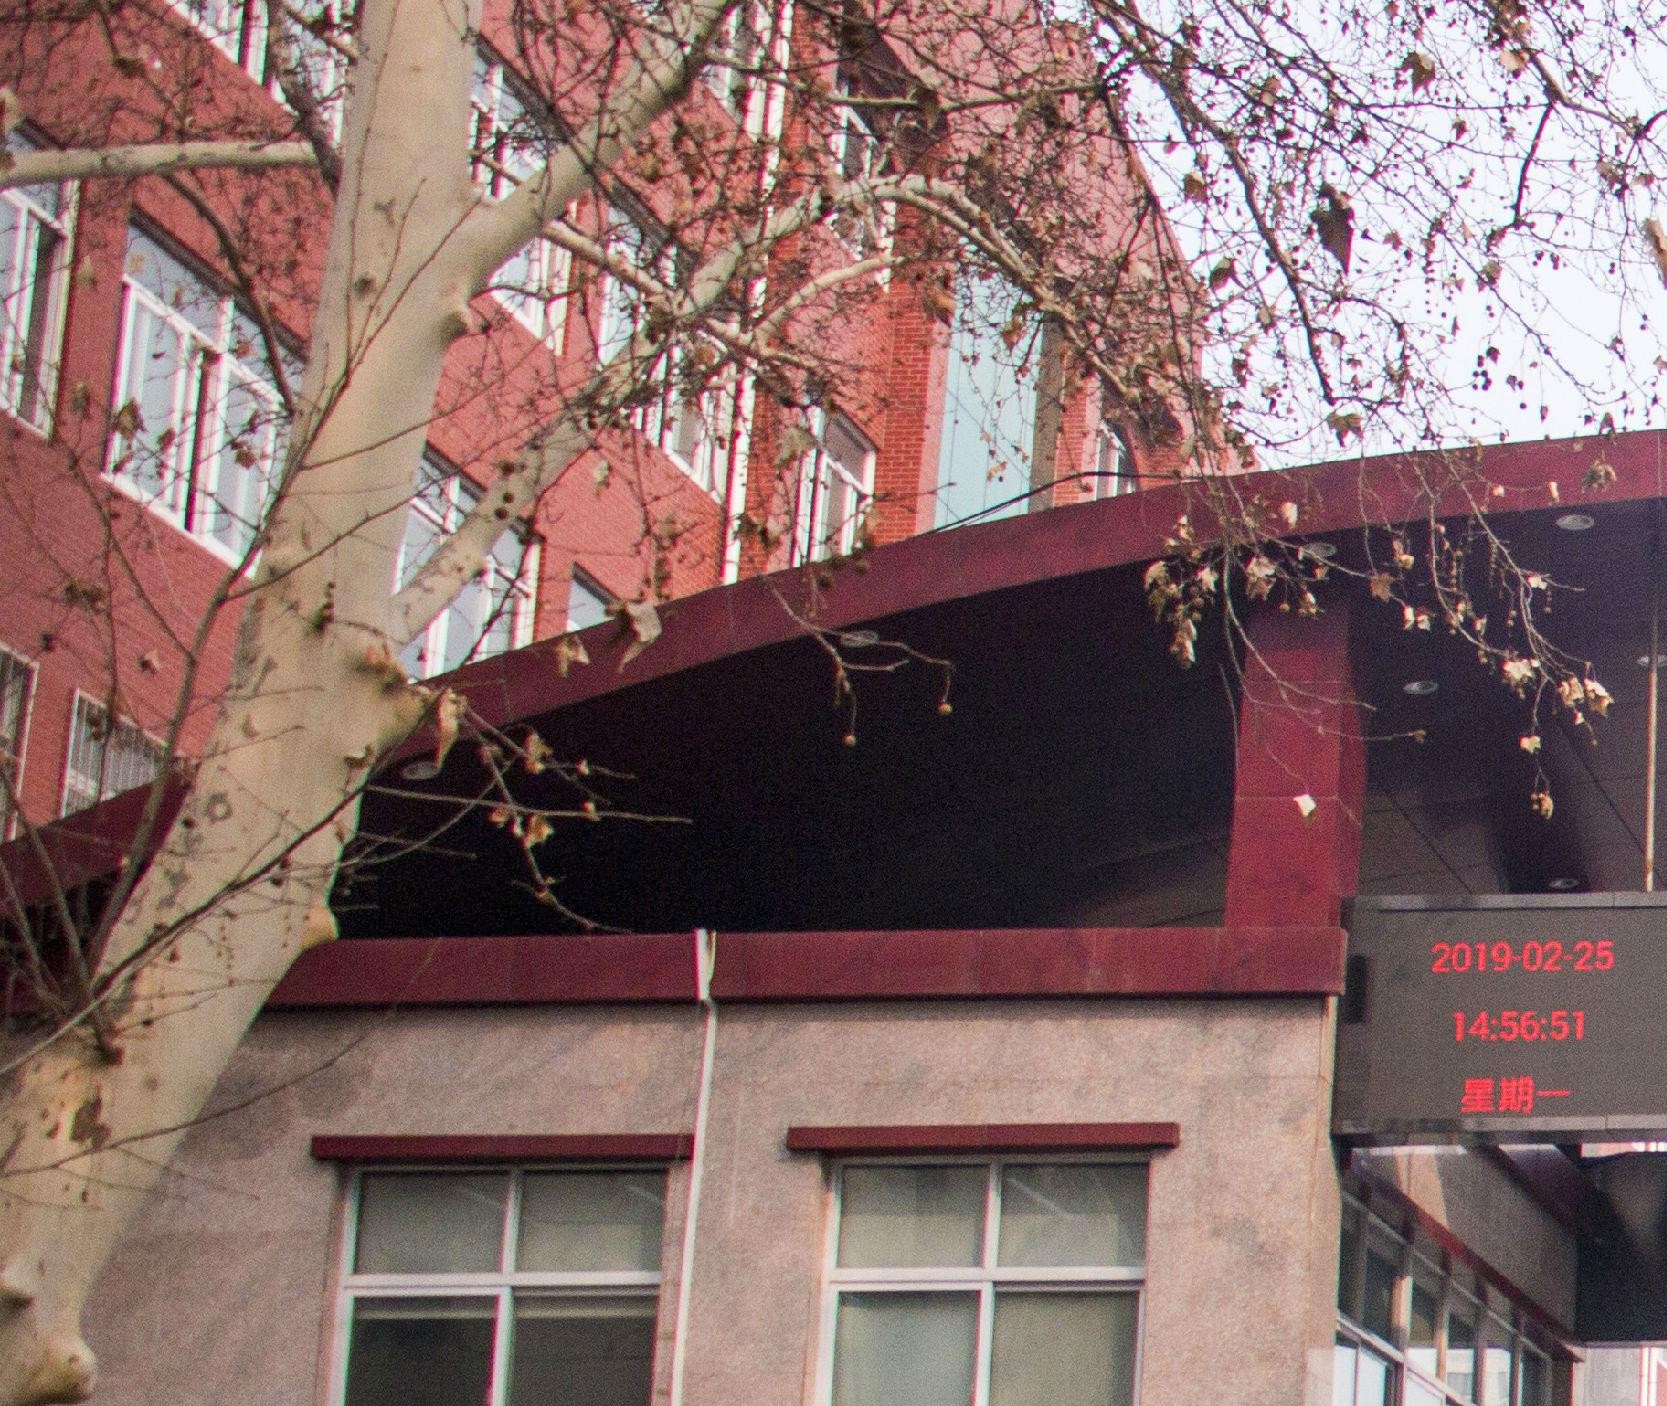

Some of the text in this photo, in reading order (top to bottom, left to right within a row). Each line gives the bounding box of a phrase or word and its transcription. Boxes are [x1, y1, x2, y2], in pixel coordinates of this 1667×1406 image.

[1432, 940, 1617, 975] 2019-02-25
[1454, 1010, 1586, 1043] 14:56:51
[1461, 1076, 1571, 1115] 星期一
